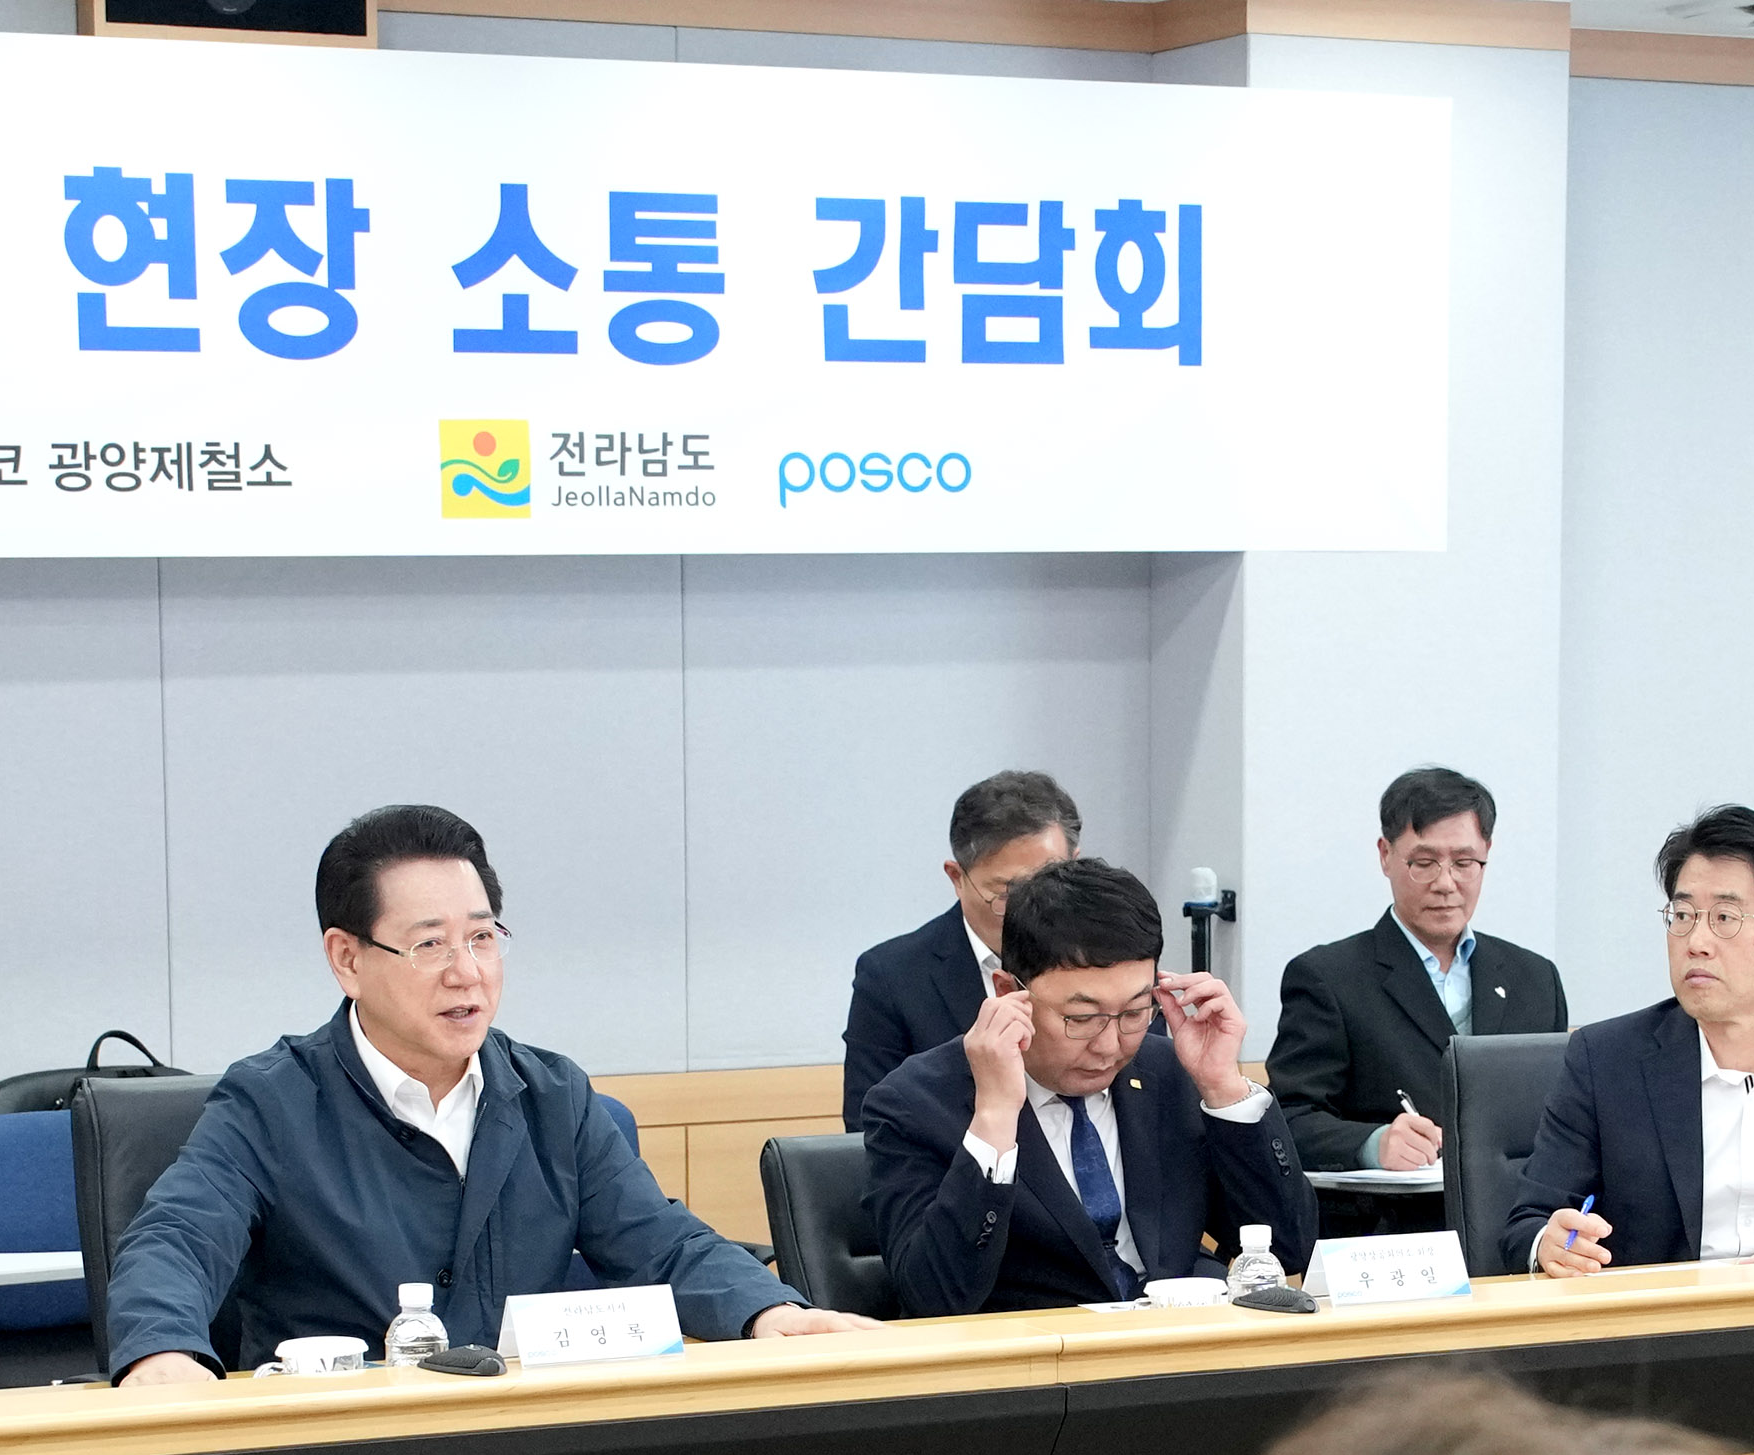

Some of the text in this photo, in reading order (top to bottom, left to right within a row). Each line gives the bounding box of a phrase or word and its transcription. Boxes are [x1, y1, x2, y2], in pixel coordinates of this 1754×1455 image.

[63, 165, 371, 361] 현장
[450, 182, 726, 366] 소통
[812, 195, 1203, 367] 간담회
[48, 440, 293, 493] 광양제철소
[549, 431, 715, 478] 전라남도
[778, 451, 972, 509] posco
[551, 484, 716, 507] JeollaNamdo
